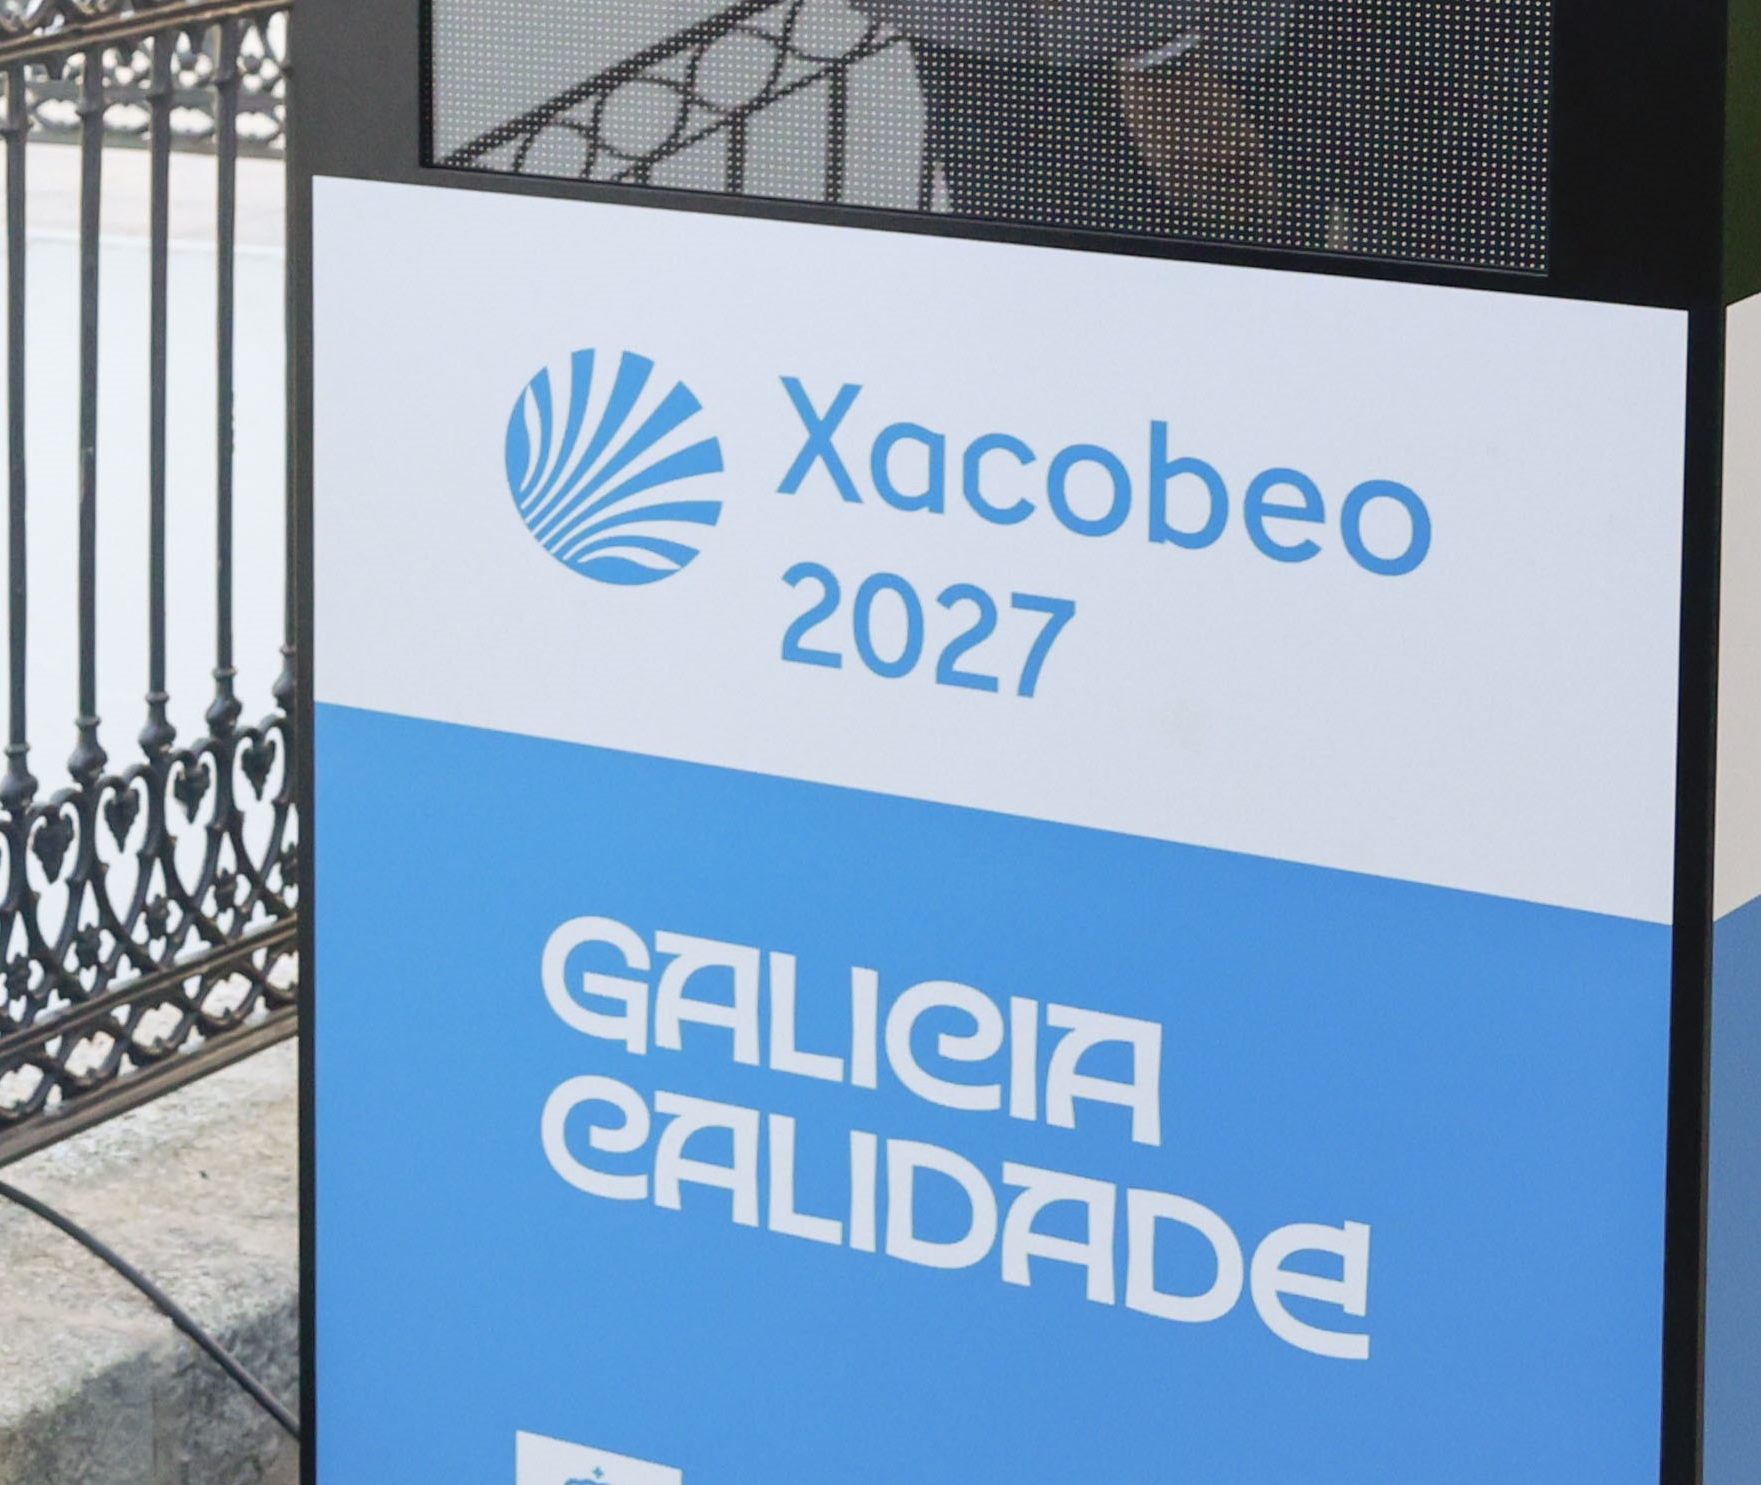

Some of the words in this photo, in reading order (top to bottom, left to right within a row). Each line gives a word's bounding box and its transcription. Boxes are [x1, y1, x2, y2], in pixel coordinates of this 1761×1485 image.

[776, 374, 1432, 577] Xacobeo
[779, 561, 1077, 698] 2027
[540, 915, 1163, 1147] GALICIA
[540, 1074, 1370, 1360] CALIDADE
